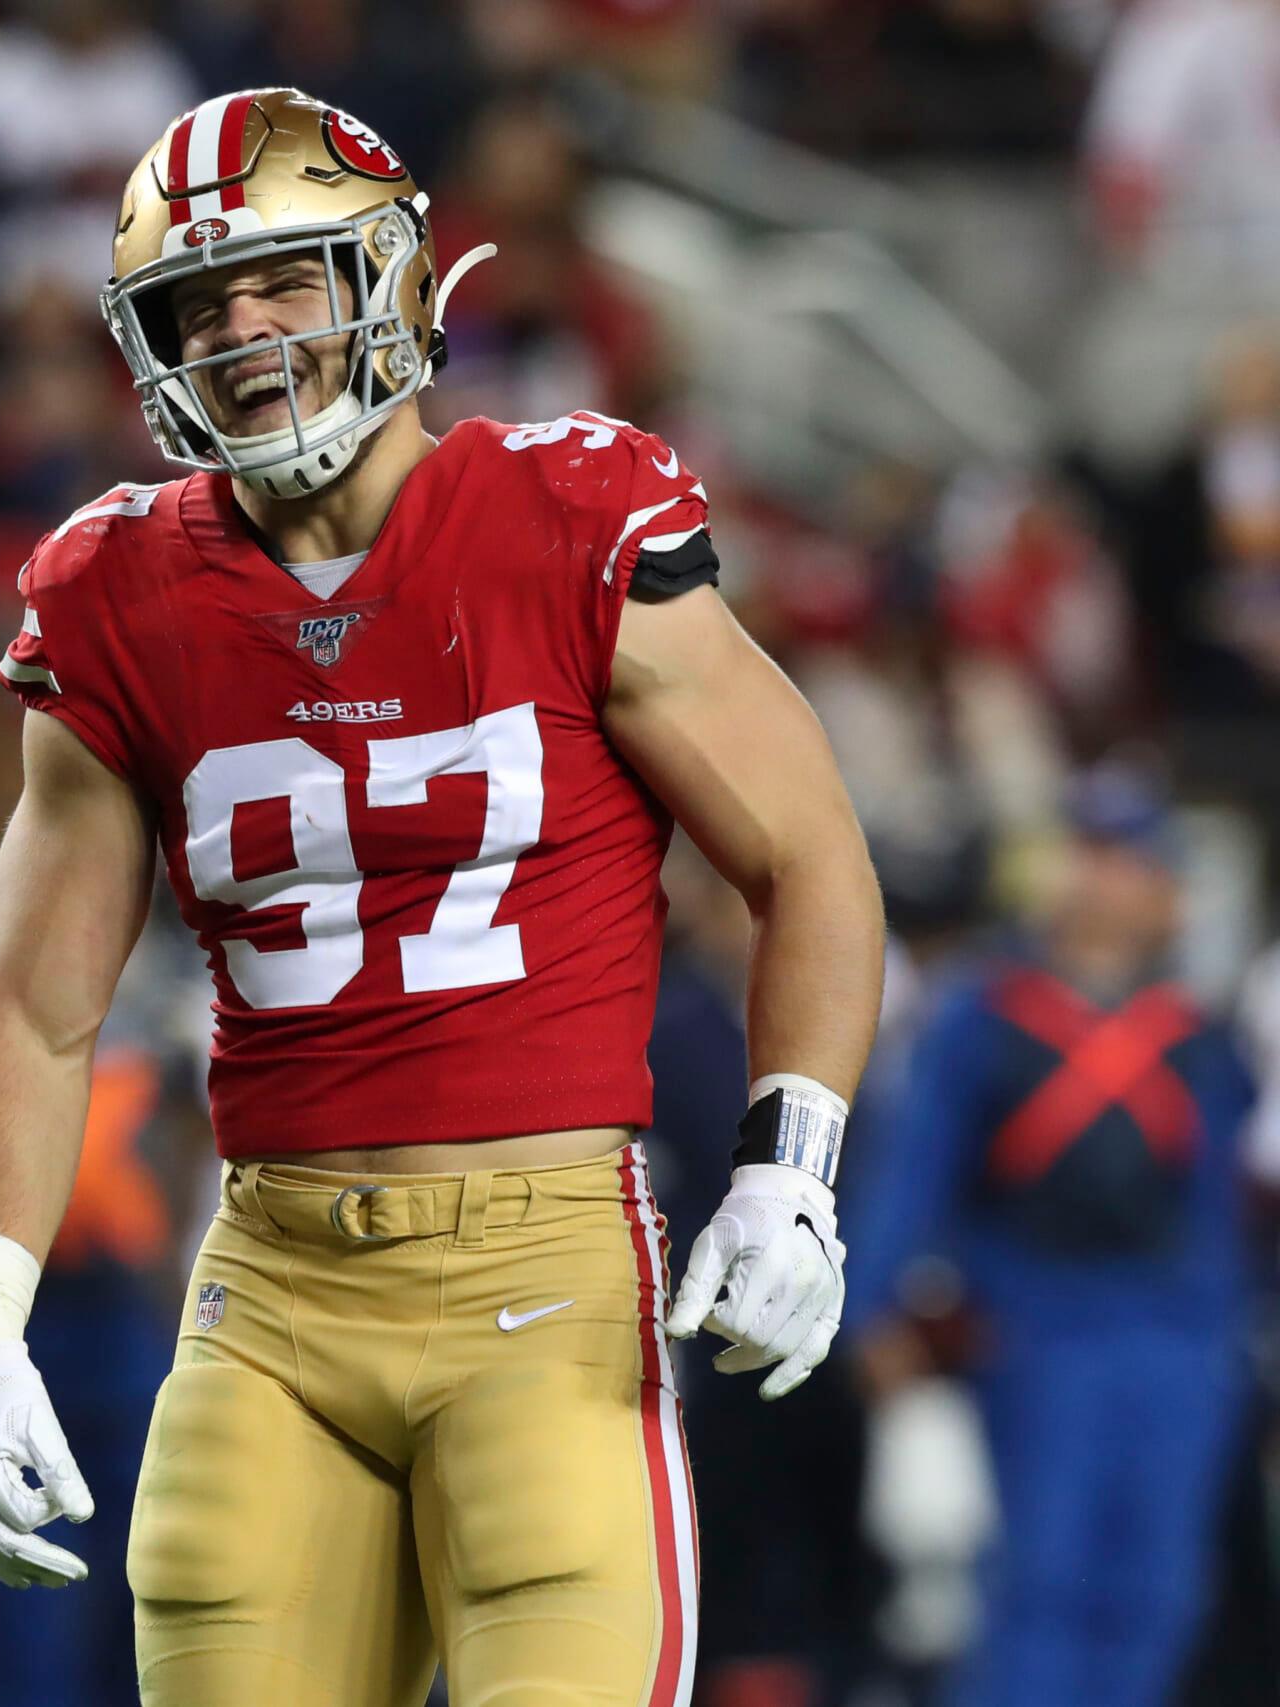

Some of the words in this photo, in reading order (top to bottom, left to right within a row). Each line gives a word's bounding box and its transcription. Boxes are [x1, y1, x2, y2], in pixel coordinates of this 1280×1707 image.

[286, 698, 404, 723] 49ERS
[183, 701, 544, 1010] 97
[199, 1303, 219, 1321] NFL
